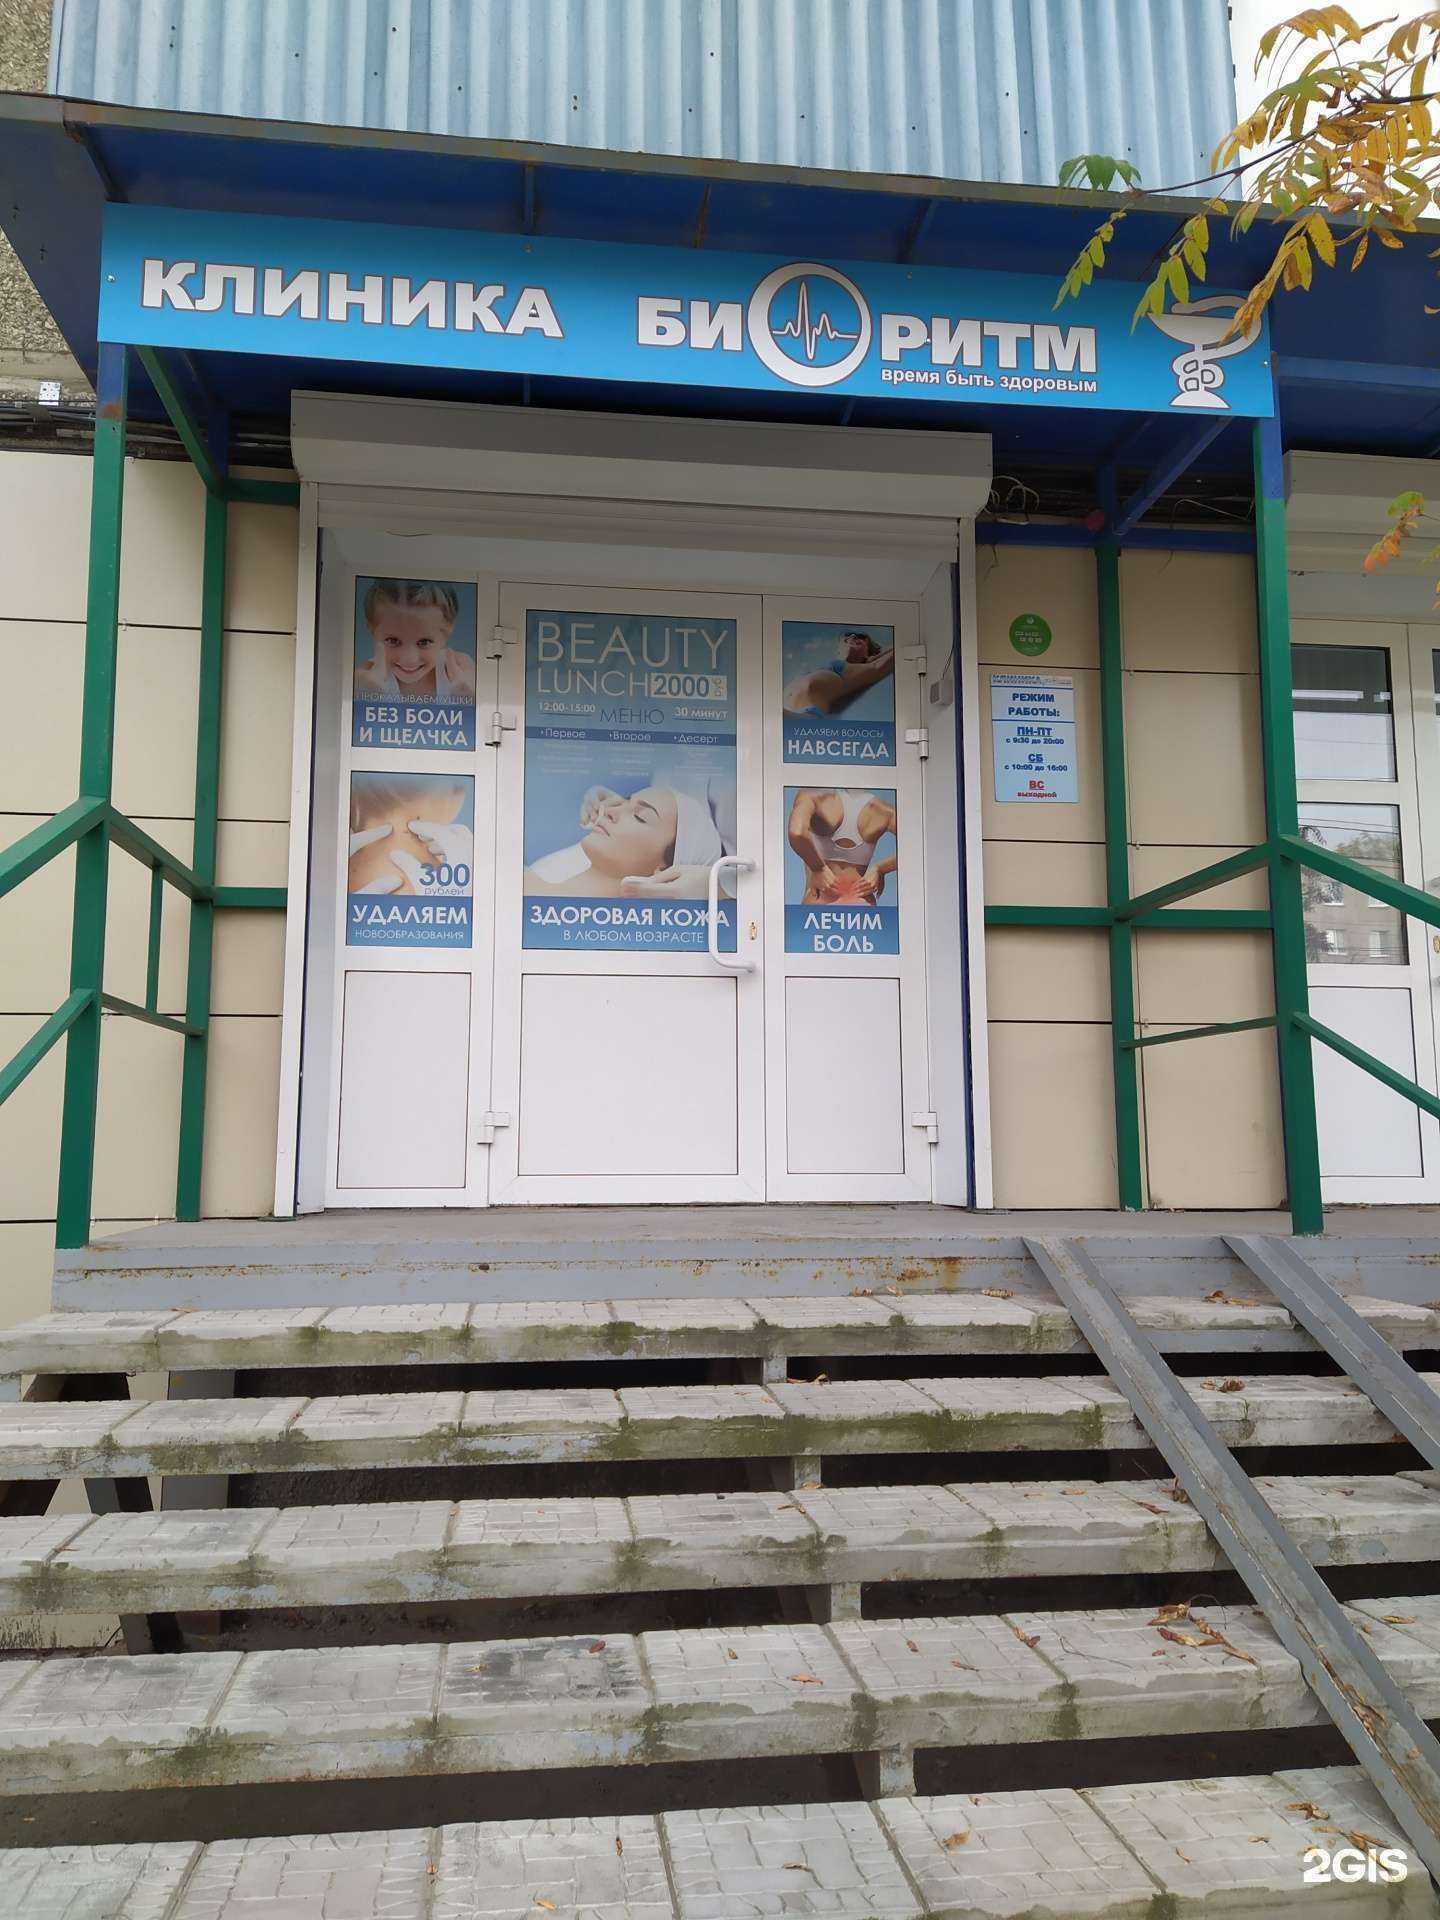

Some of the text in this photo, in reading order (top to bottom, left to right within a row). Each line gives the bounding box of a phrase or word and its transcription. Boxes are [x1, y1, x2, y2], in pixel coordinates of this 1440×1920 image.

[141, 258, 565, 338] КЛИНИКА
[881, 368, 1098, 393] время быть здоровым
[537, 621, 729, 669] BEAUTY
[537, 667, 649, 697] LUNCH
[654, 674, 710, 698] 2000
[1012, 692, 1055, 703] РЕЖИМ
[365, 706, 463, 725] БЕЗ БОЛИ
[599, 706, 665, 725] МЕНЮ
[1008, 706, 1060, 718] РАБОТЫ:
[359, 726, 468, 746] И ЩЕЛЧКА
[1017, 726, 1053, 737] ПН-ПТ
[788, 739, 890, 759] НАВСЕГДА
[1028, 753, 1044, 763] СБ
[1029, 780, 1045, 790] ВС
[419, 863, 470, 887] 300
[352, 904, 468, 925] УДАЛЯЕМ
[530, 905, 653, 927] ЗДОРОВАЯ
[804, 913, 882, 930] ЛЕЧИМ
[355, 929, 464, 940] НОВООБРАЗОВАНИЯ
[563, 930, 704, 943] В ЛЮБОМ ВОЗРАСТЕ
[814, 935, 874, 952] БОЛЬ
